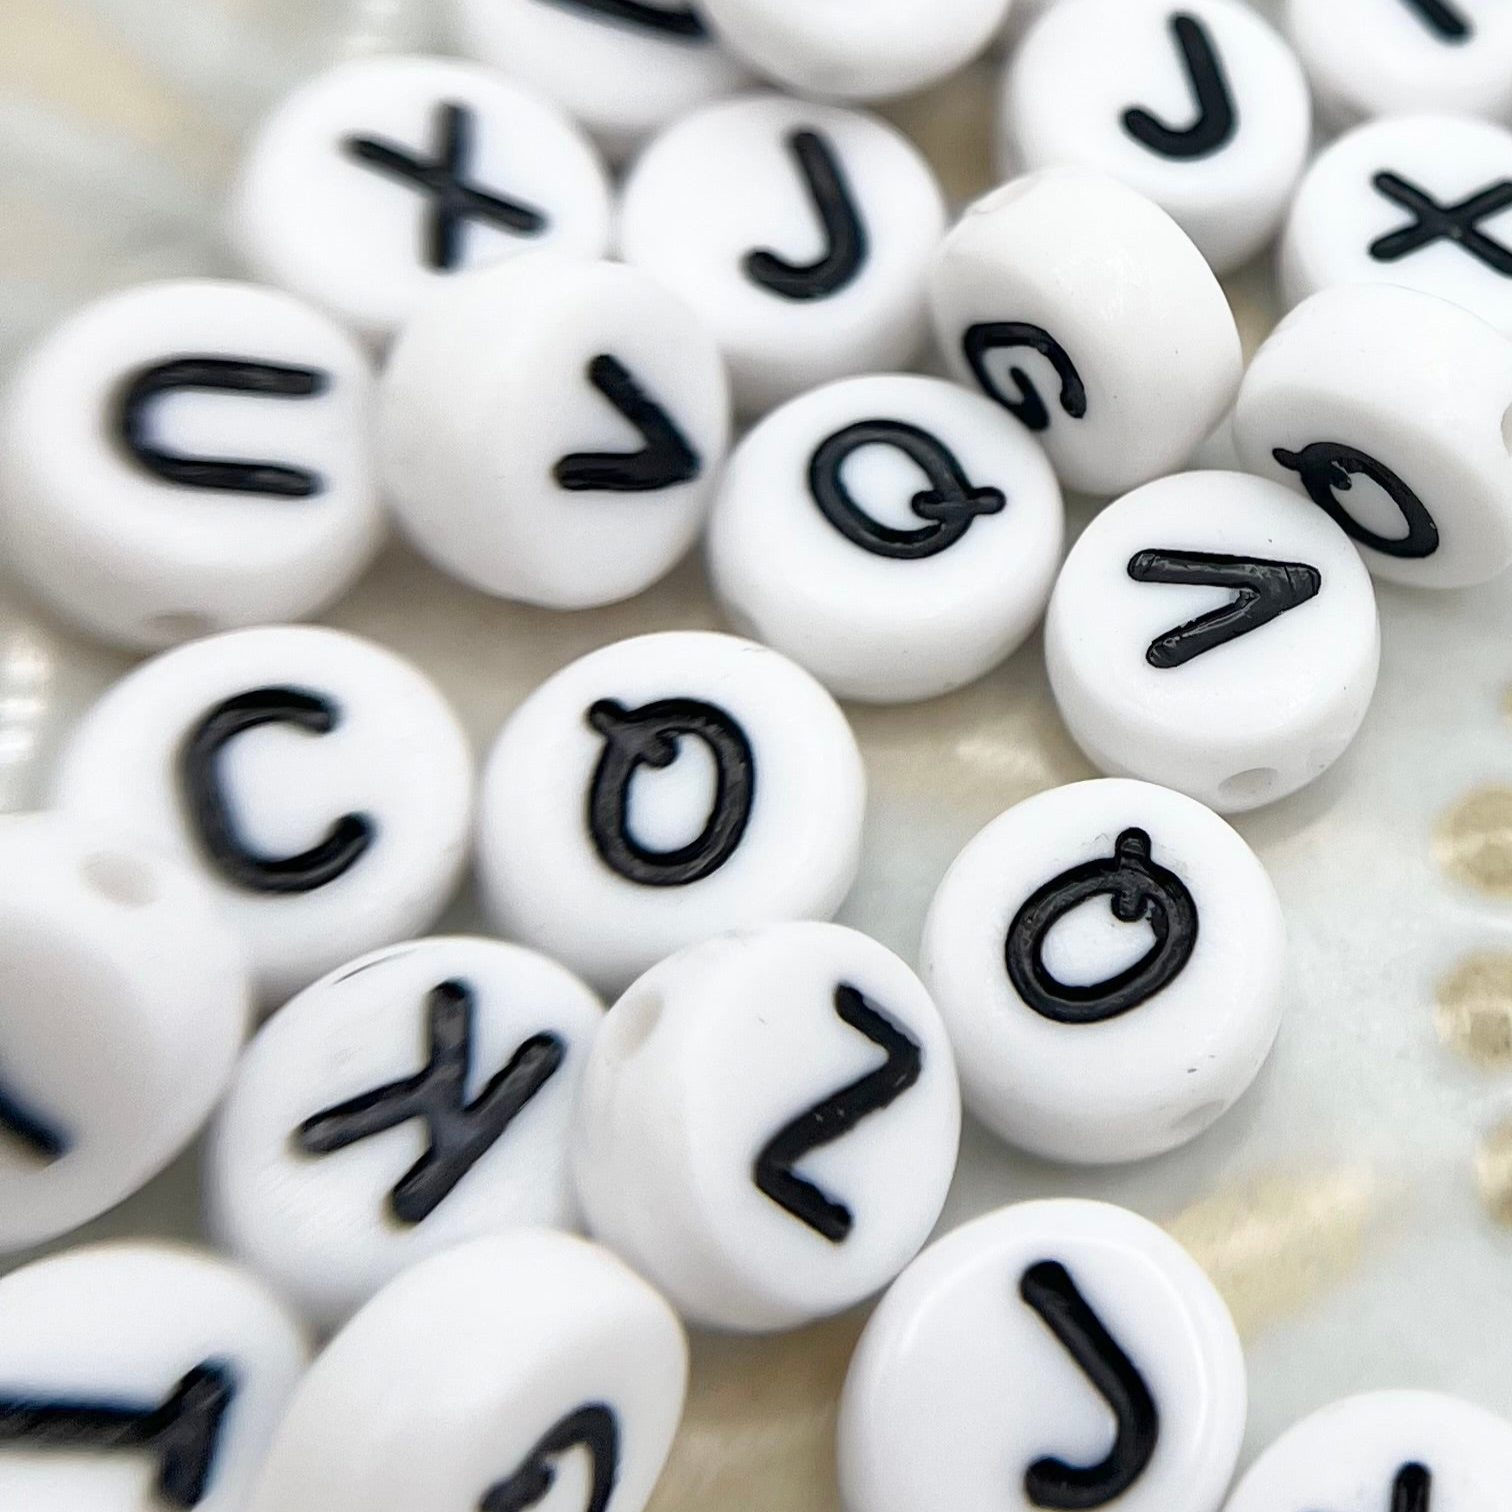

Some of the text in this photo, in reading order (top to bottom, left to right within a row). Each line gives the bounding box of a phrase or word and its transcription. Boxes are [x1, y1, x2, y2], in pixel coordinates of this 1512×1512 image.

[1121, 13, 1236, 161] J
[346, 100, 548, 271] X
[743, 128, 868, 302] J
[109, 356, 326, 500] U
[552, 354, 702, 493] V
[806, 419, 1006, 560] Q
[1271, 441, 1440, 561] Q
[1127, 549, 1321, 669] V
[177, 686, 376, 897] C
[585, 697, 756, 888] Q
[1004, 827, 1199, 1025] Q
[293, 980, 567, 1228] K
[1018, 1259, 1160, 1512] J
